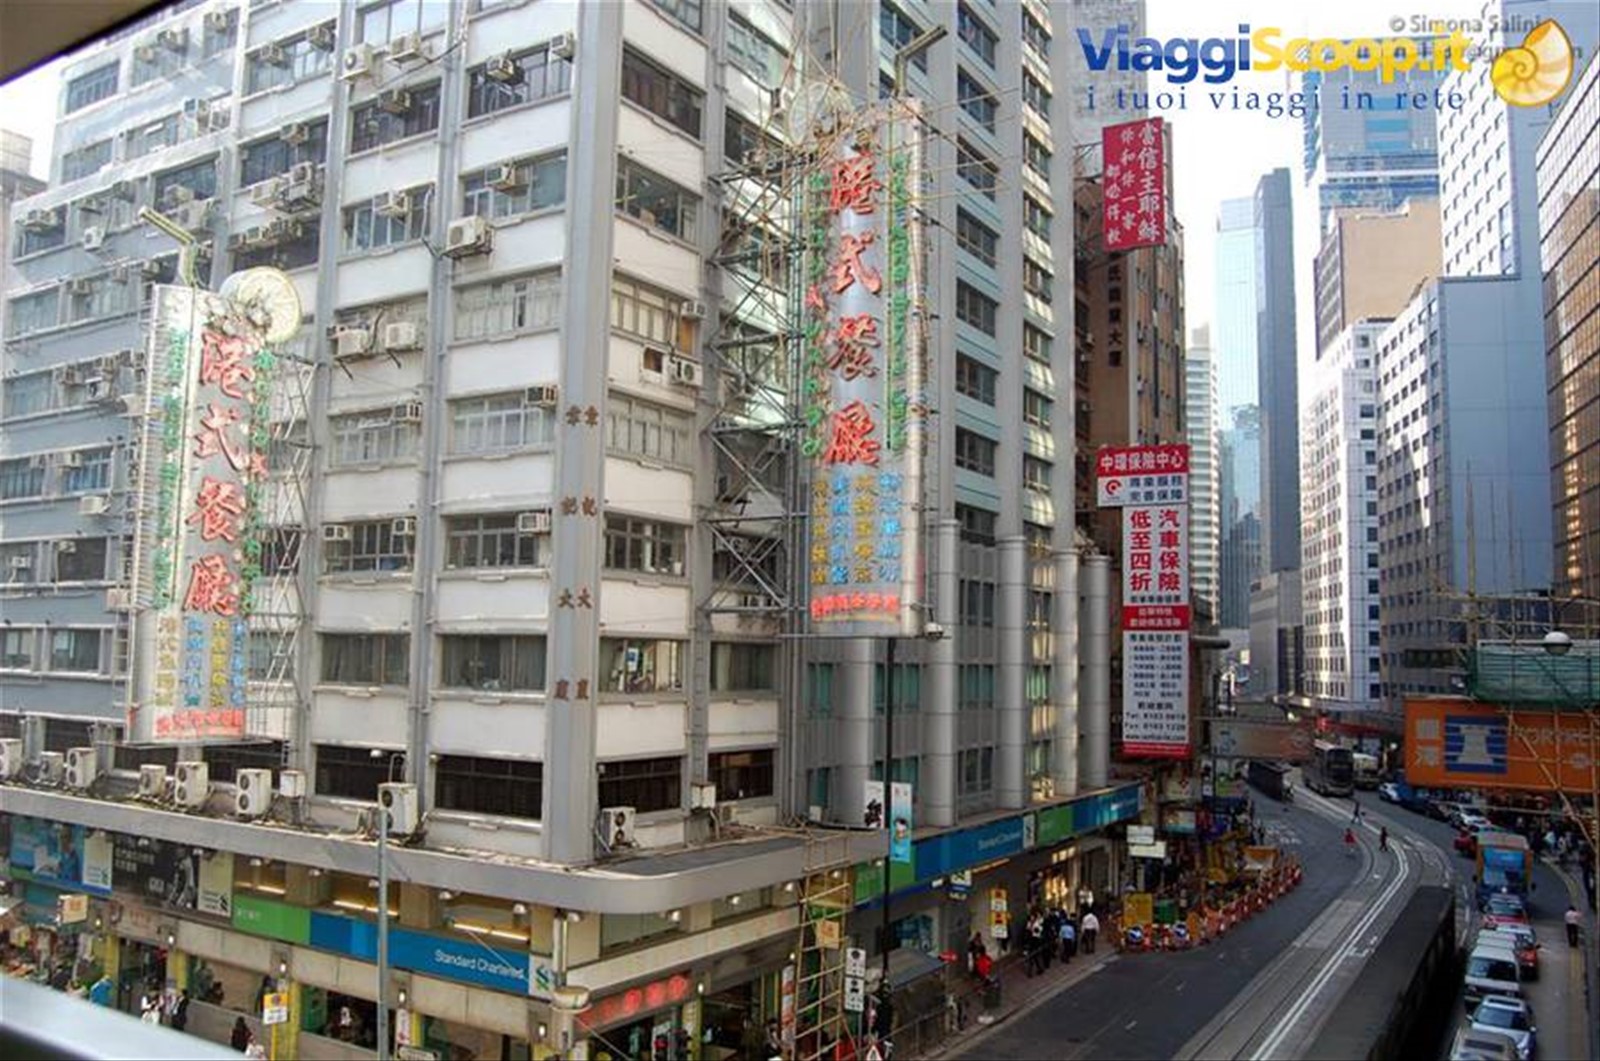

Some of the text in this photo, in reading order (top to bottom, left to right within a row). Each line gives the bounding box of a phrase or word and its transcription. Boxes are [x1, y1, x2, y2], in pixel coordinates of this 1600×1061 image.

[1138, 121, 1160, 242] 當信主耶穌
[1101, 450, 1184, 472] 中環保險中心
[1130, 510, 1152, 591] 低至四折
[1159, 509, 1180, 591] 汽車保險
[434, 949, 476, 969] Standard
